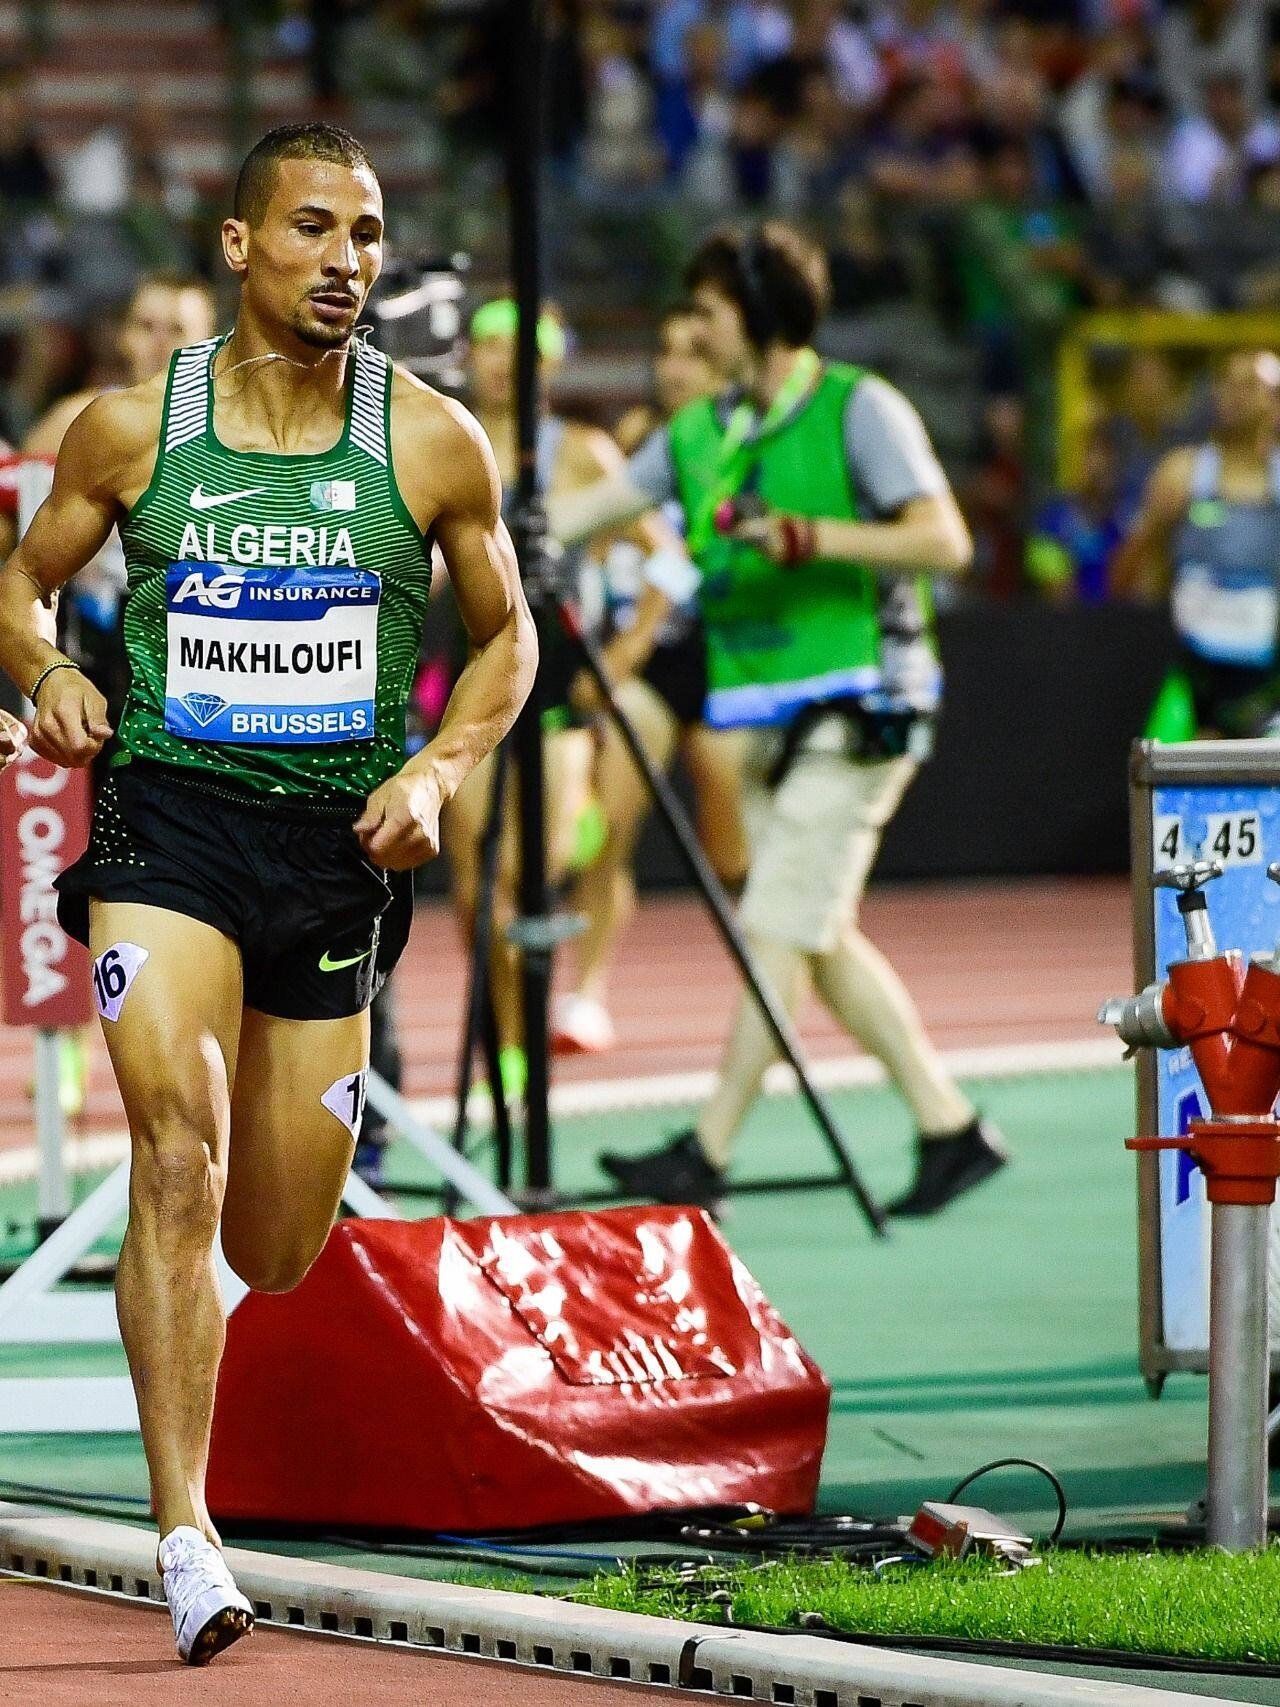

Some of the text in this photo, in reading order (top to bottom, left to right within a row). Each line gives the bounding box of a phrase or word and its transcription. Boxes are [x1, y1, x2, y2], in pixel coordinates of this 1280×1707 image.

[177, 522, 357, 568] ALGERIA
[171, 572, 372, 609] AG INSURANCE
[180, 636, 362, 675] MAKHLOUFI
[231, 709, 367, 735] BRUSSELS
[1160, 817, 1256, 860] 4 45
[18, 805, 69, 1008] OMEGA
[93, 949, 127, 1010] 16
